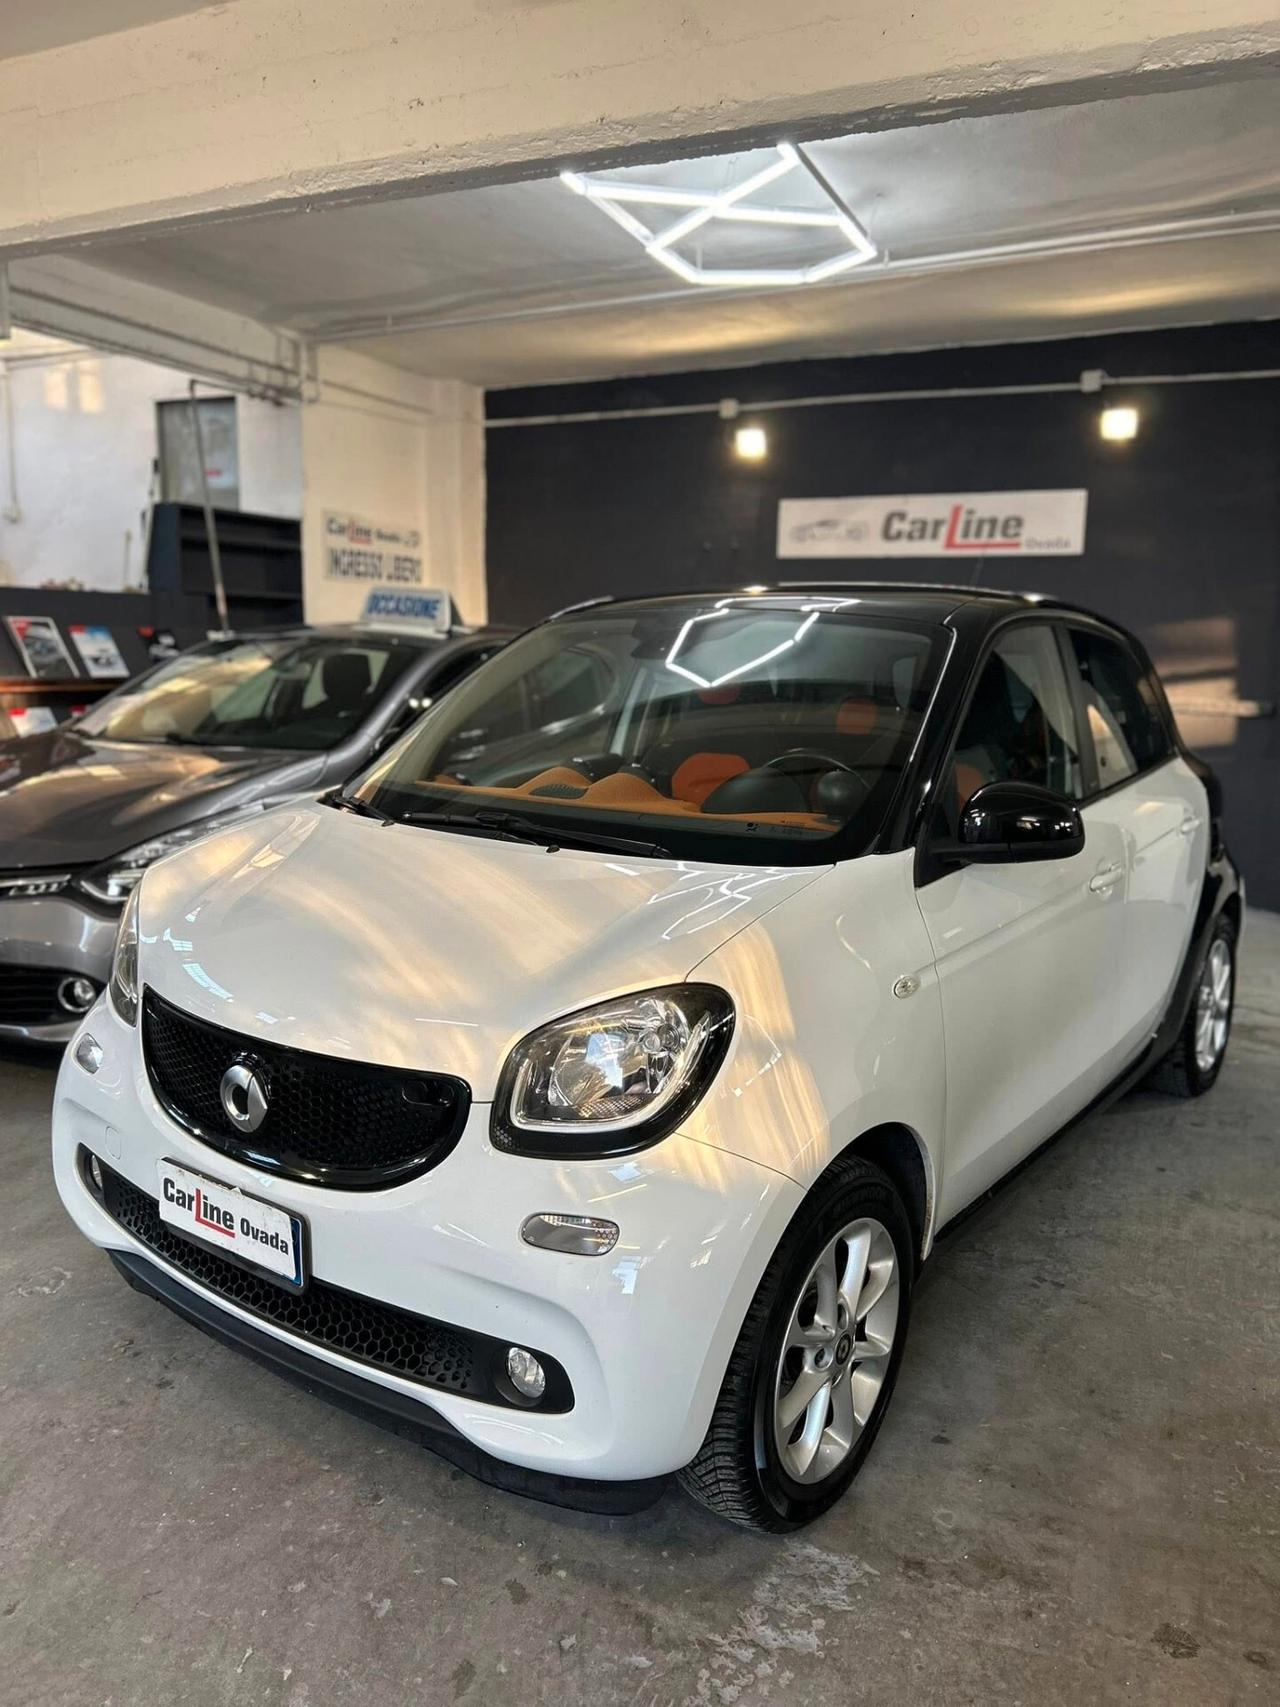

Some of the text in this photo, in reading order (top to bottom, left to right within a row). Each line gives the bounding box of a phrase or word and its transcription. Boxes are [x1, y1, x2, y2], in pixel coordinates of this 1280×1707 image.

[881, 503, 1024, 550] CarLine
[367, 594, 441, 619] OCCASIONE
[163, 1177, 289, 1256] CarLine Ovada
